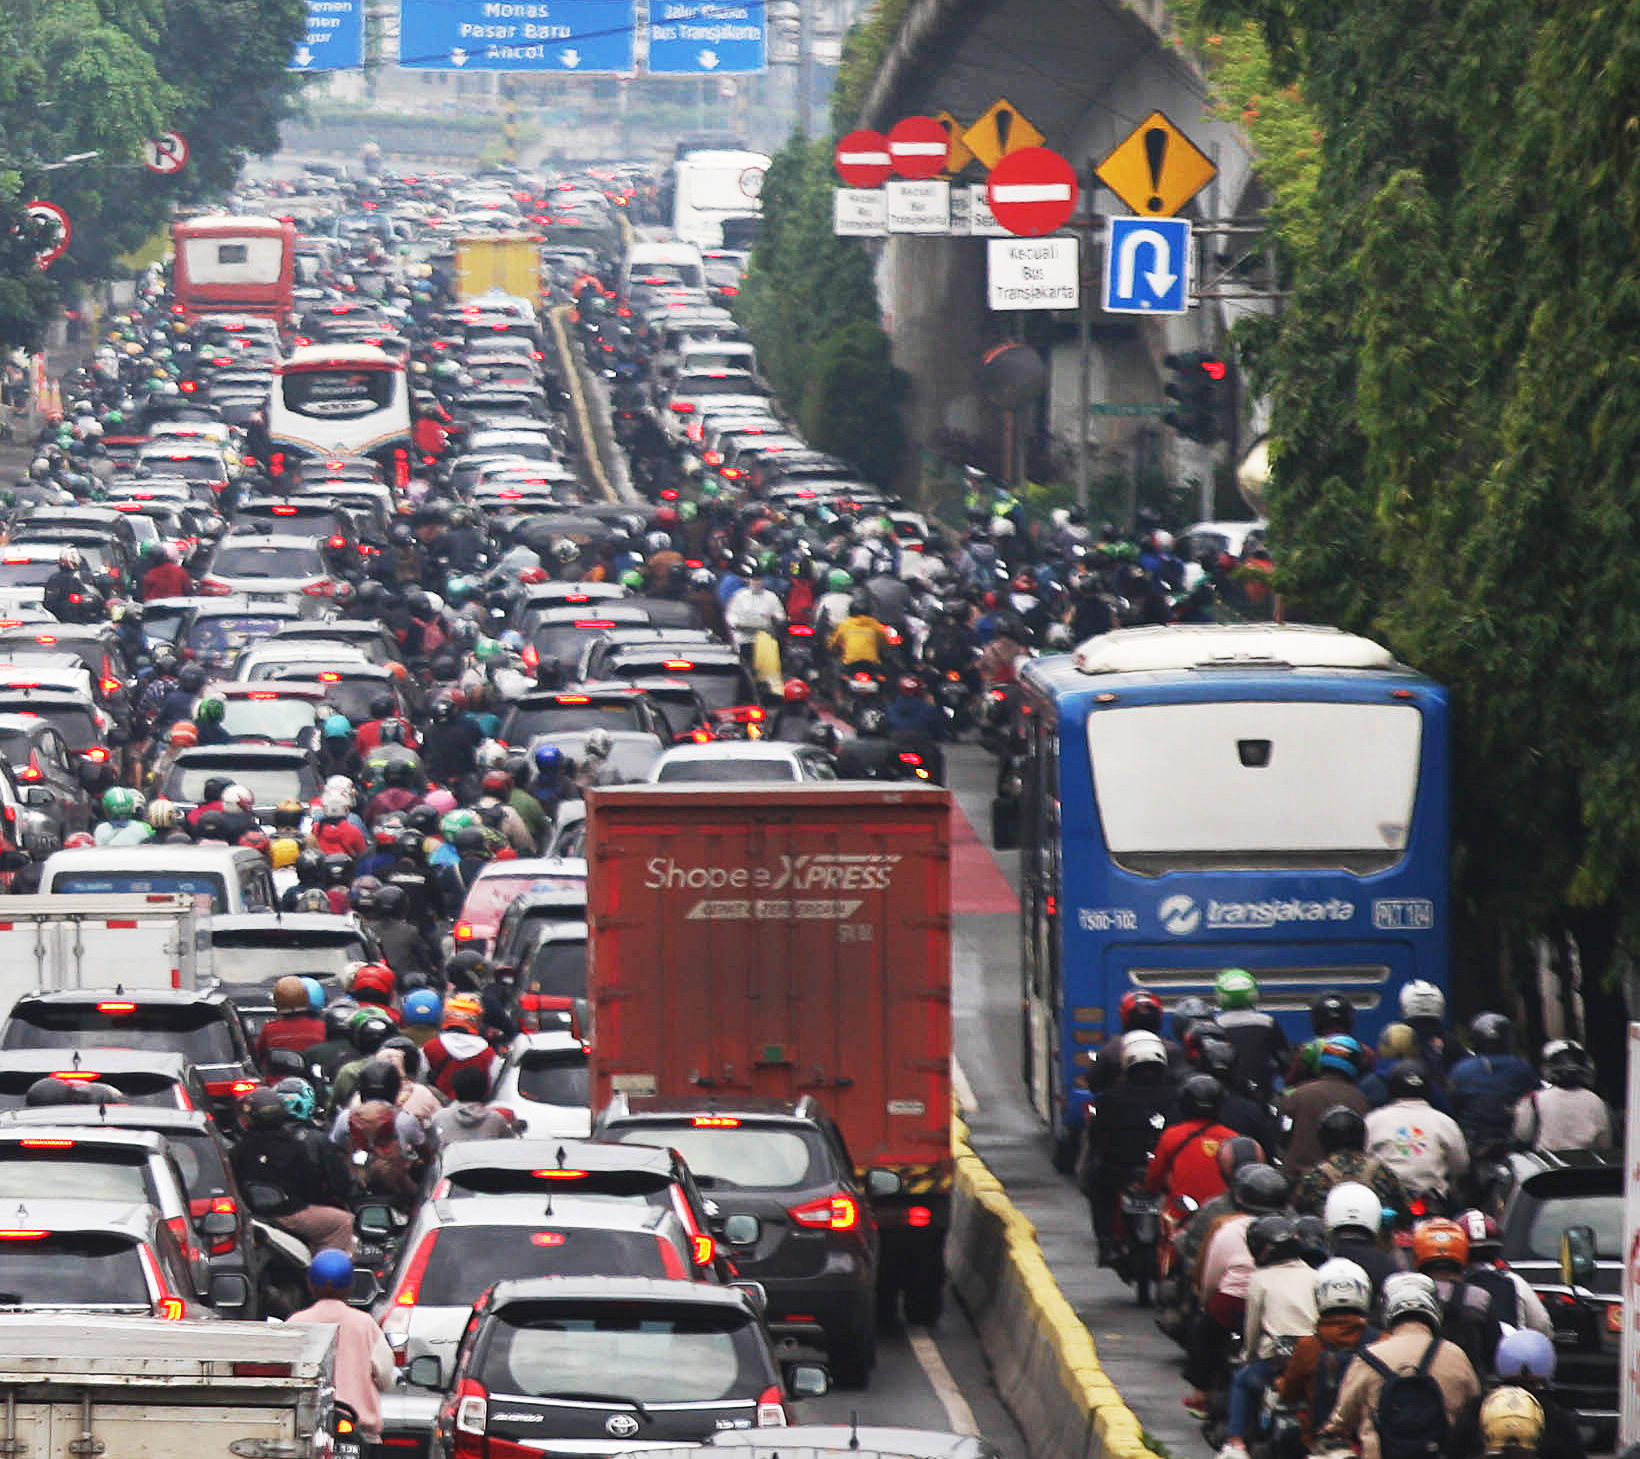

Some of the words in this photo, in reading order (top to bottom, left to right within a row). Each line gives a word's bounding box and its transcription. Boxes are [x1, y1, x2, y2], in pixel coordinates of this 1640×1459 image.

[485, 3, 549, 18] Monas
[460, 24, 515, 38] Pasar
[524, 24, 571, 38] Baru
[487, 45, 544, 58] Ancol
[1010, 246, 1059, 260] Kecuali
[1022, 266, 1044, 281] Bus
[997, 286, 1074, 304] Transjakarta
[644, 858, 771, 889] Shopee
[772, 855, 893, 890] XPRESS
[1207, 900, 1356, 924] transjakarta
